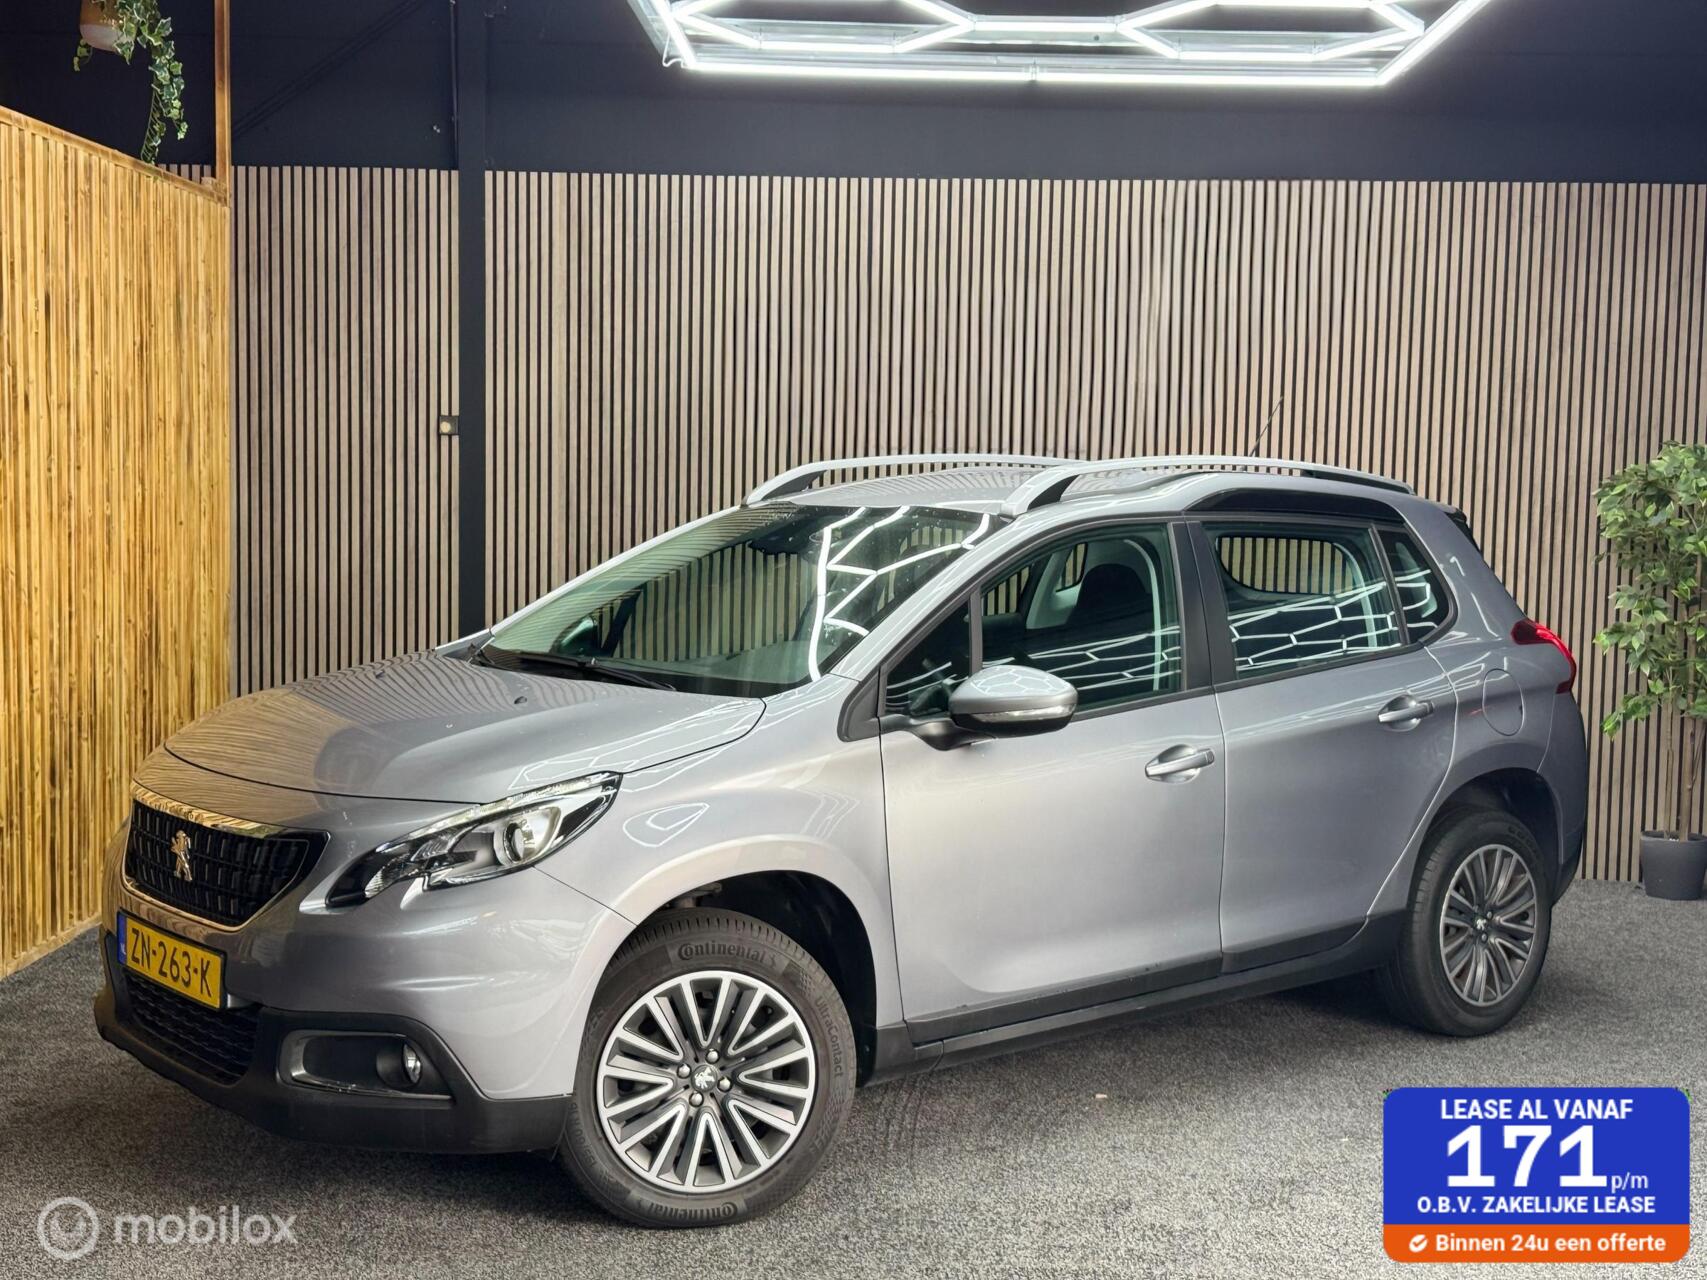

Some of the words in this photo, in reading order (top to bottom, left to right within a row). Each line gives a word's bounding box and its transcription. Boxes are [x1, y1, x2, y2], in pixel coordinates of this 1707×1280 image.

[131, 927, 211, 998] ZN-263-K
[677, 940, 767, 962] Continental
[816, 996, 844, 1078] UltraContact
[649, 1201, 738, 1220] Continental
